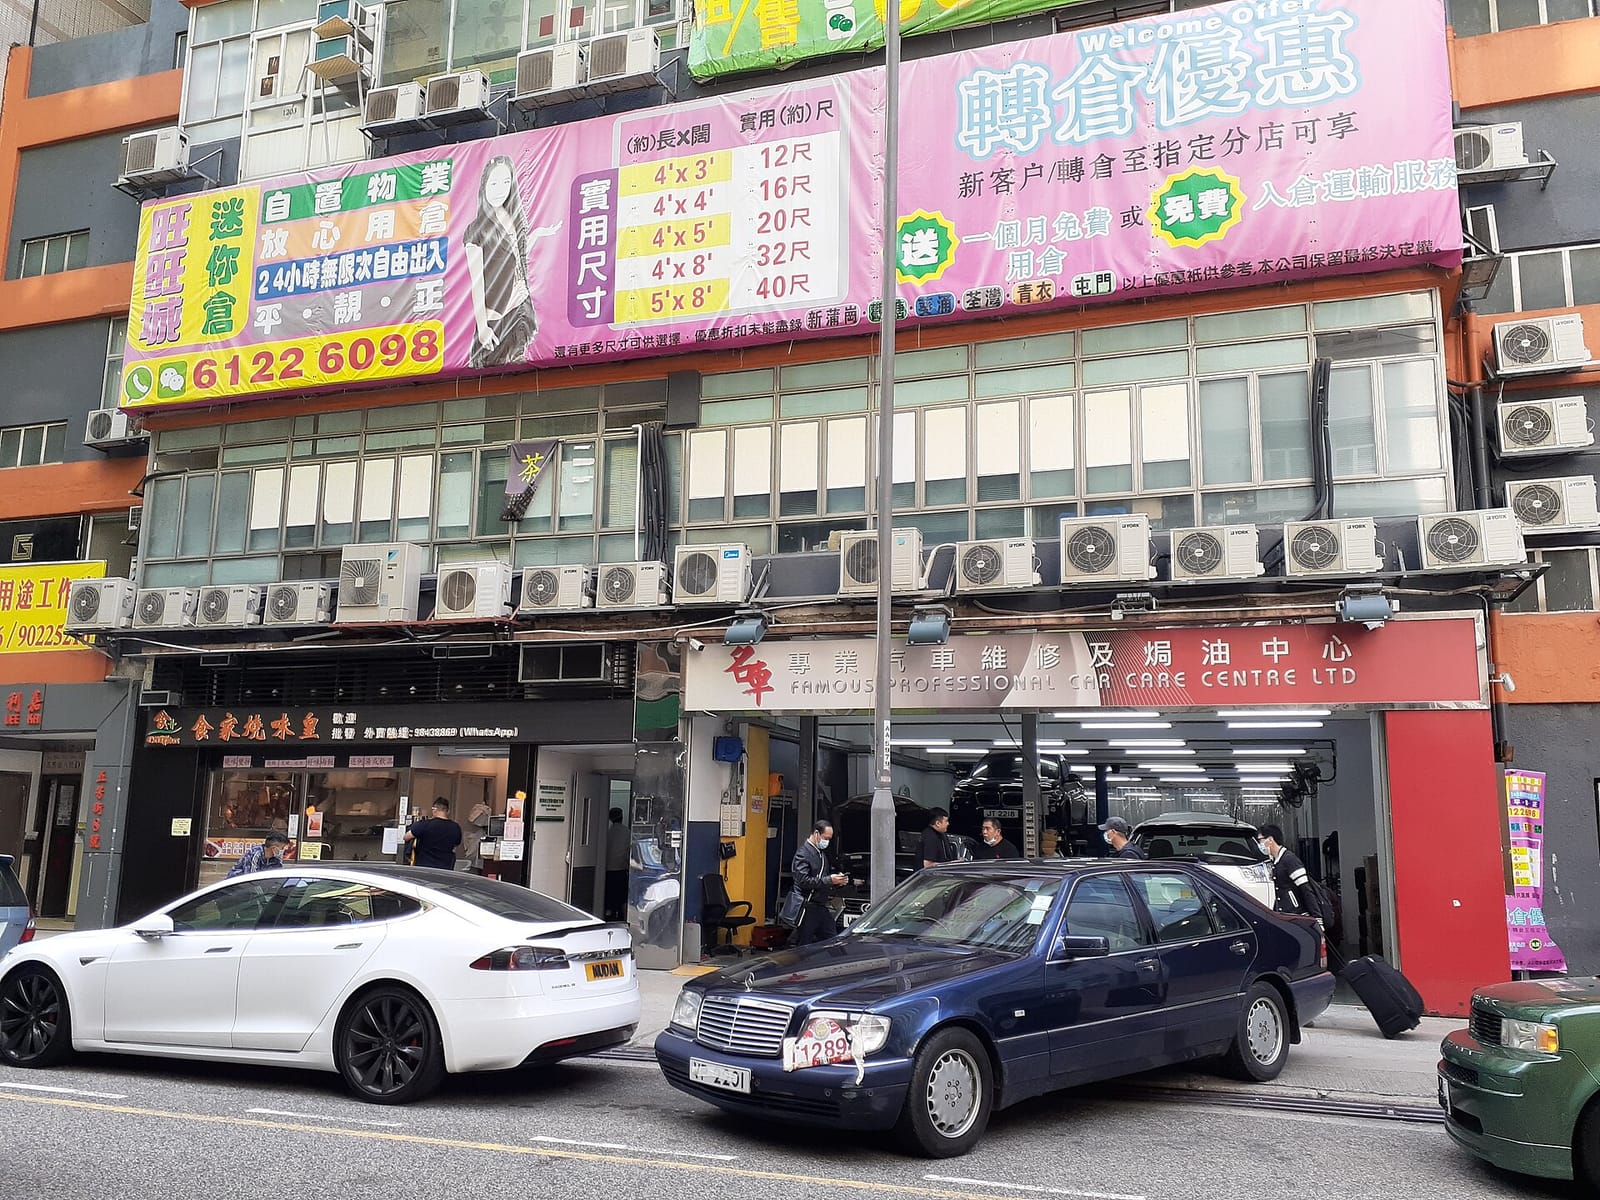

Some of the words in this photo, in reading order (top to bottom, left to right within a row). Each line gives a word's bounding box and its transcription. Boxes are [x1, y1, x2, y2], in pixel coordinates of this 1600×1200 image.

[1081, 17, 1222, 52] Welcome
[961, 10, 1356, 157] 轉倉優惠
[760, 142, 813, 169] 12尺
[265, 160, 450, 222] 自置物業
[759, 175, 812, 201] 16尺
[757, 207, 811, 234] 20尺
[901, 227, 940, 268] 送
[962, 207, 1114, 248] 一個月免費
[1120, 205, 1143, 228] 或
[1163, 186, 1231, 223] 免費
[1252, 157, 1457, 212] 入倉運輸服務
[259, 200, 449, 260] 放心用倉
[201, 196, 245, 336] 迷你倉
[576, 178, 611, 320] 實用尺寸
[757, 241, 811, 266] 32尺
[1007, 247, 1067, 281] 用倉
[138, 202, 192, 347] 旺旺城
[756, 274, 811, 299] 40尺
[1015, 281, 1055, 304] 青衣
[1073, 273, 1113, 296] 屯門
[192, 348, 306, 389] 6122
[318, 328, 439, 371] 6098
[518, 452, 544, 484] 茶
[791, 678, 874, 695] FAMOUS
[1068, 672, 1112, 690] CAR
[1126, 671, 1187, 688] CARE
[1201, 668, 1297, 687] CENTRE
[1312, 666, 1357, 685] LTD
